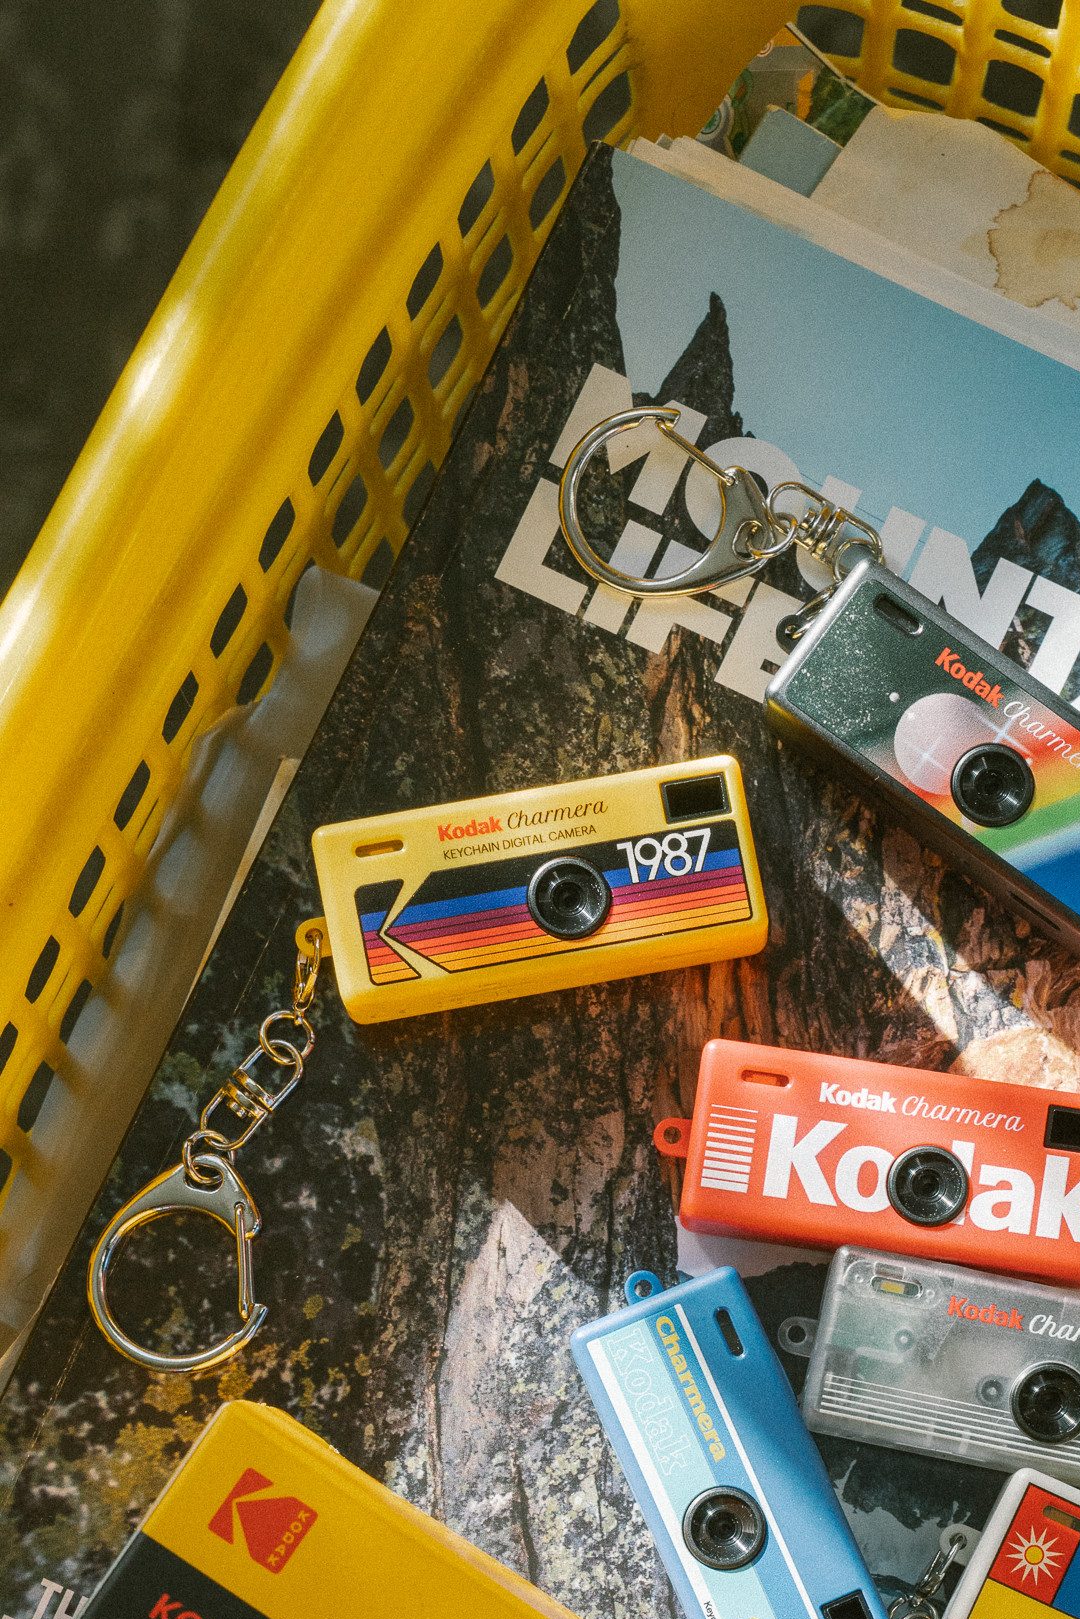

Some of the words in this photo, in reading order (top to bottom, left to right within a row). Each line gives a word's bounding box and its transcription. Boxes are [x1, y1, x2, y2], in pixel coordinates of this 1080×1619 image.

[934, 646, 1005, 708] Kodak
[437, 816, 503, 842] Kodak
[506, 800, 609, 831] Charmera
[443, 841, 501, 861] KEYCHAIN
[502, 832, 546, 851] DIGITAL
[548, 824, 597, 843] CAMERA
[616, 828, 712, 884] 1987
[819, 1082, 898, 1114] Kodak
[901, 1096, 1025, 1132] Charmera
[947, 1296, 1024, 1332] Kodak
[604, 1322, 699, 1478] Kodak
[655, 1315, 727, 1463] Charmera
[266, 1511, 310, 1567] KODAK
